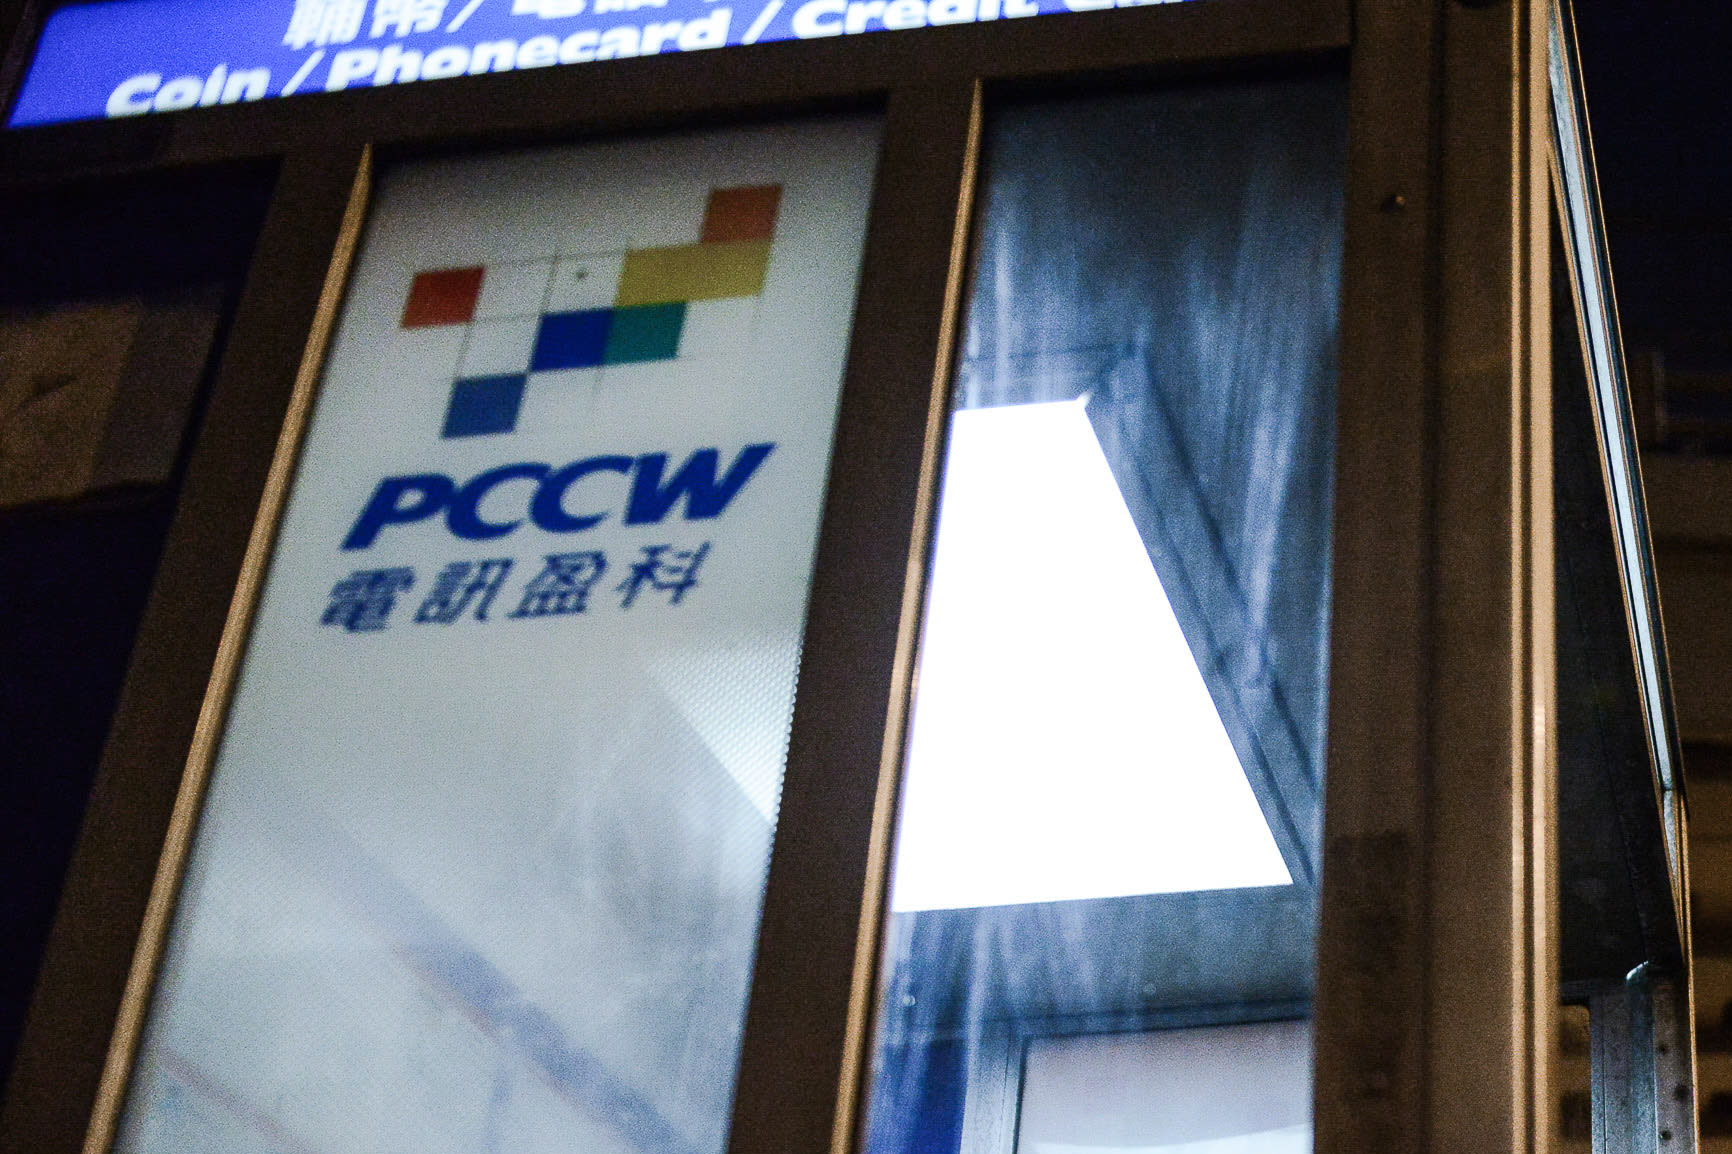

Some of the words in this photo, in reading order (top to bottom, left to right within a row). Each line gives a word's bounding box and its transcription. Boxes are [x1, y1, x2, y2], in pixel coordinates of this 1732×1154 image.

[105, 62, 272, 118] Coin
[324, 8, 732, 92] Phonecard
[341, 442, 778, 552] PCCW
[319, 541, 712, 632] 電訊盈科
